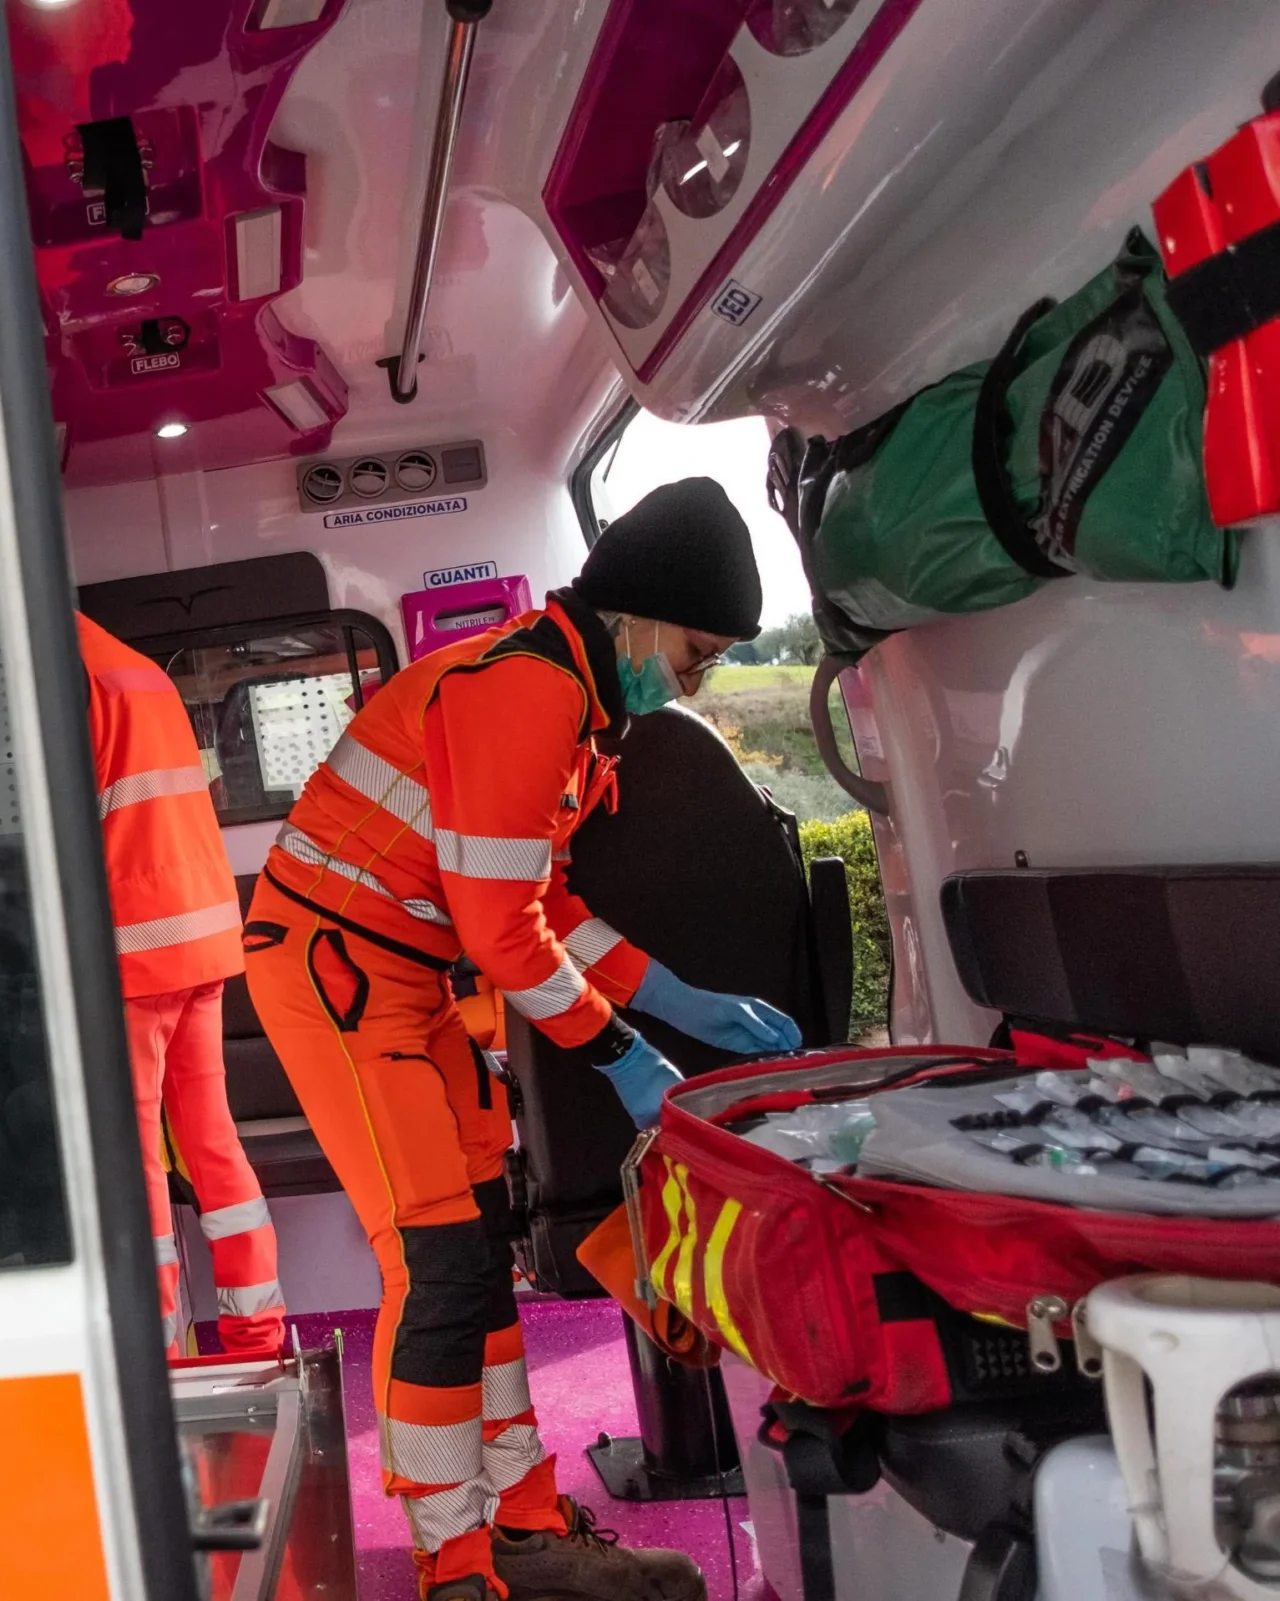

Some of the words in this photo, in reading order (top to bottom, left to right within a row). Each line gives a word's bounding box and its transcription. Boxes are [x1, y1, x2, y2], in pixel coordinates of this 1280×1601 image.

[717, 289, 750, 322] SED
[136, 354, 178, 371] FLEBO
[1108, 354, 1153, 418] DEVICE
[333, 513, 364, 526] ARIA
[366, 500, 461, 521] CONDIZIONATA
[429, 564, 490, 586] GUANTI
[455, 616, 488, 629] NITRILE
